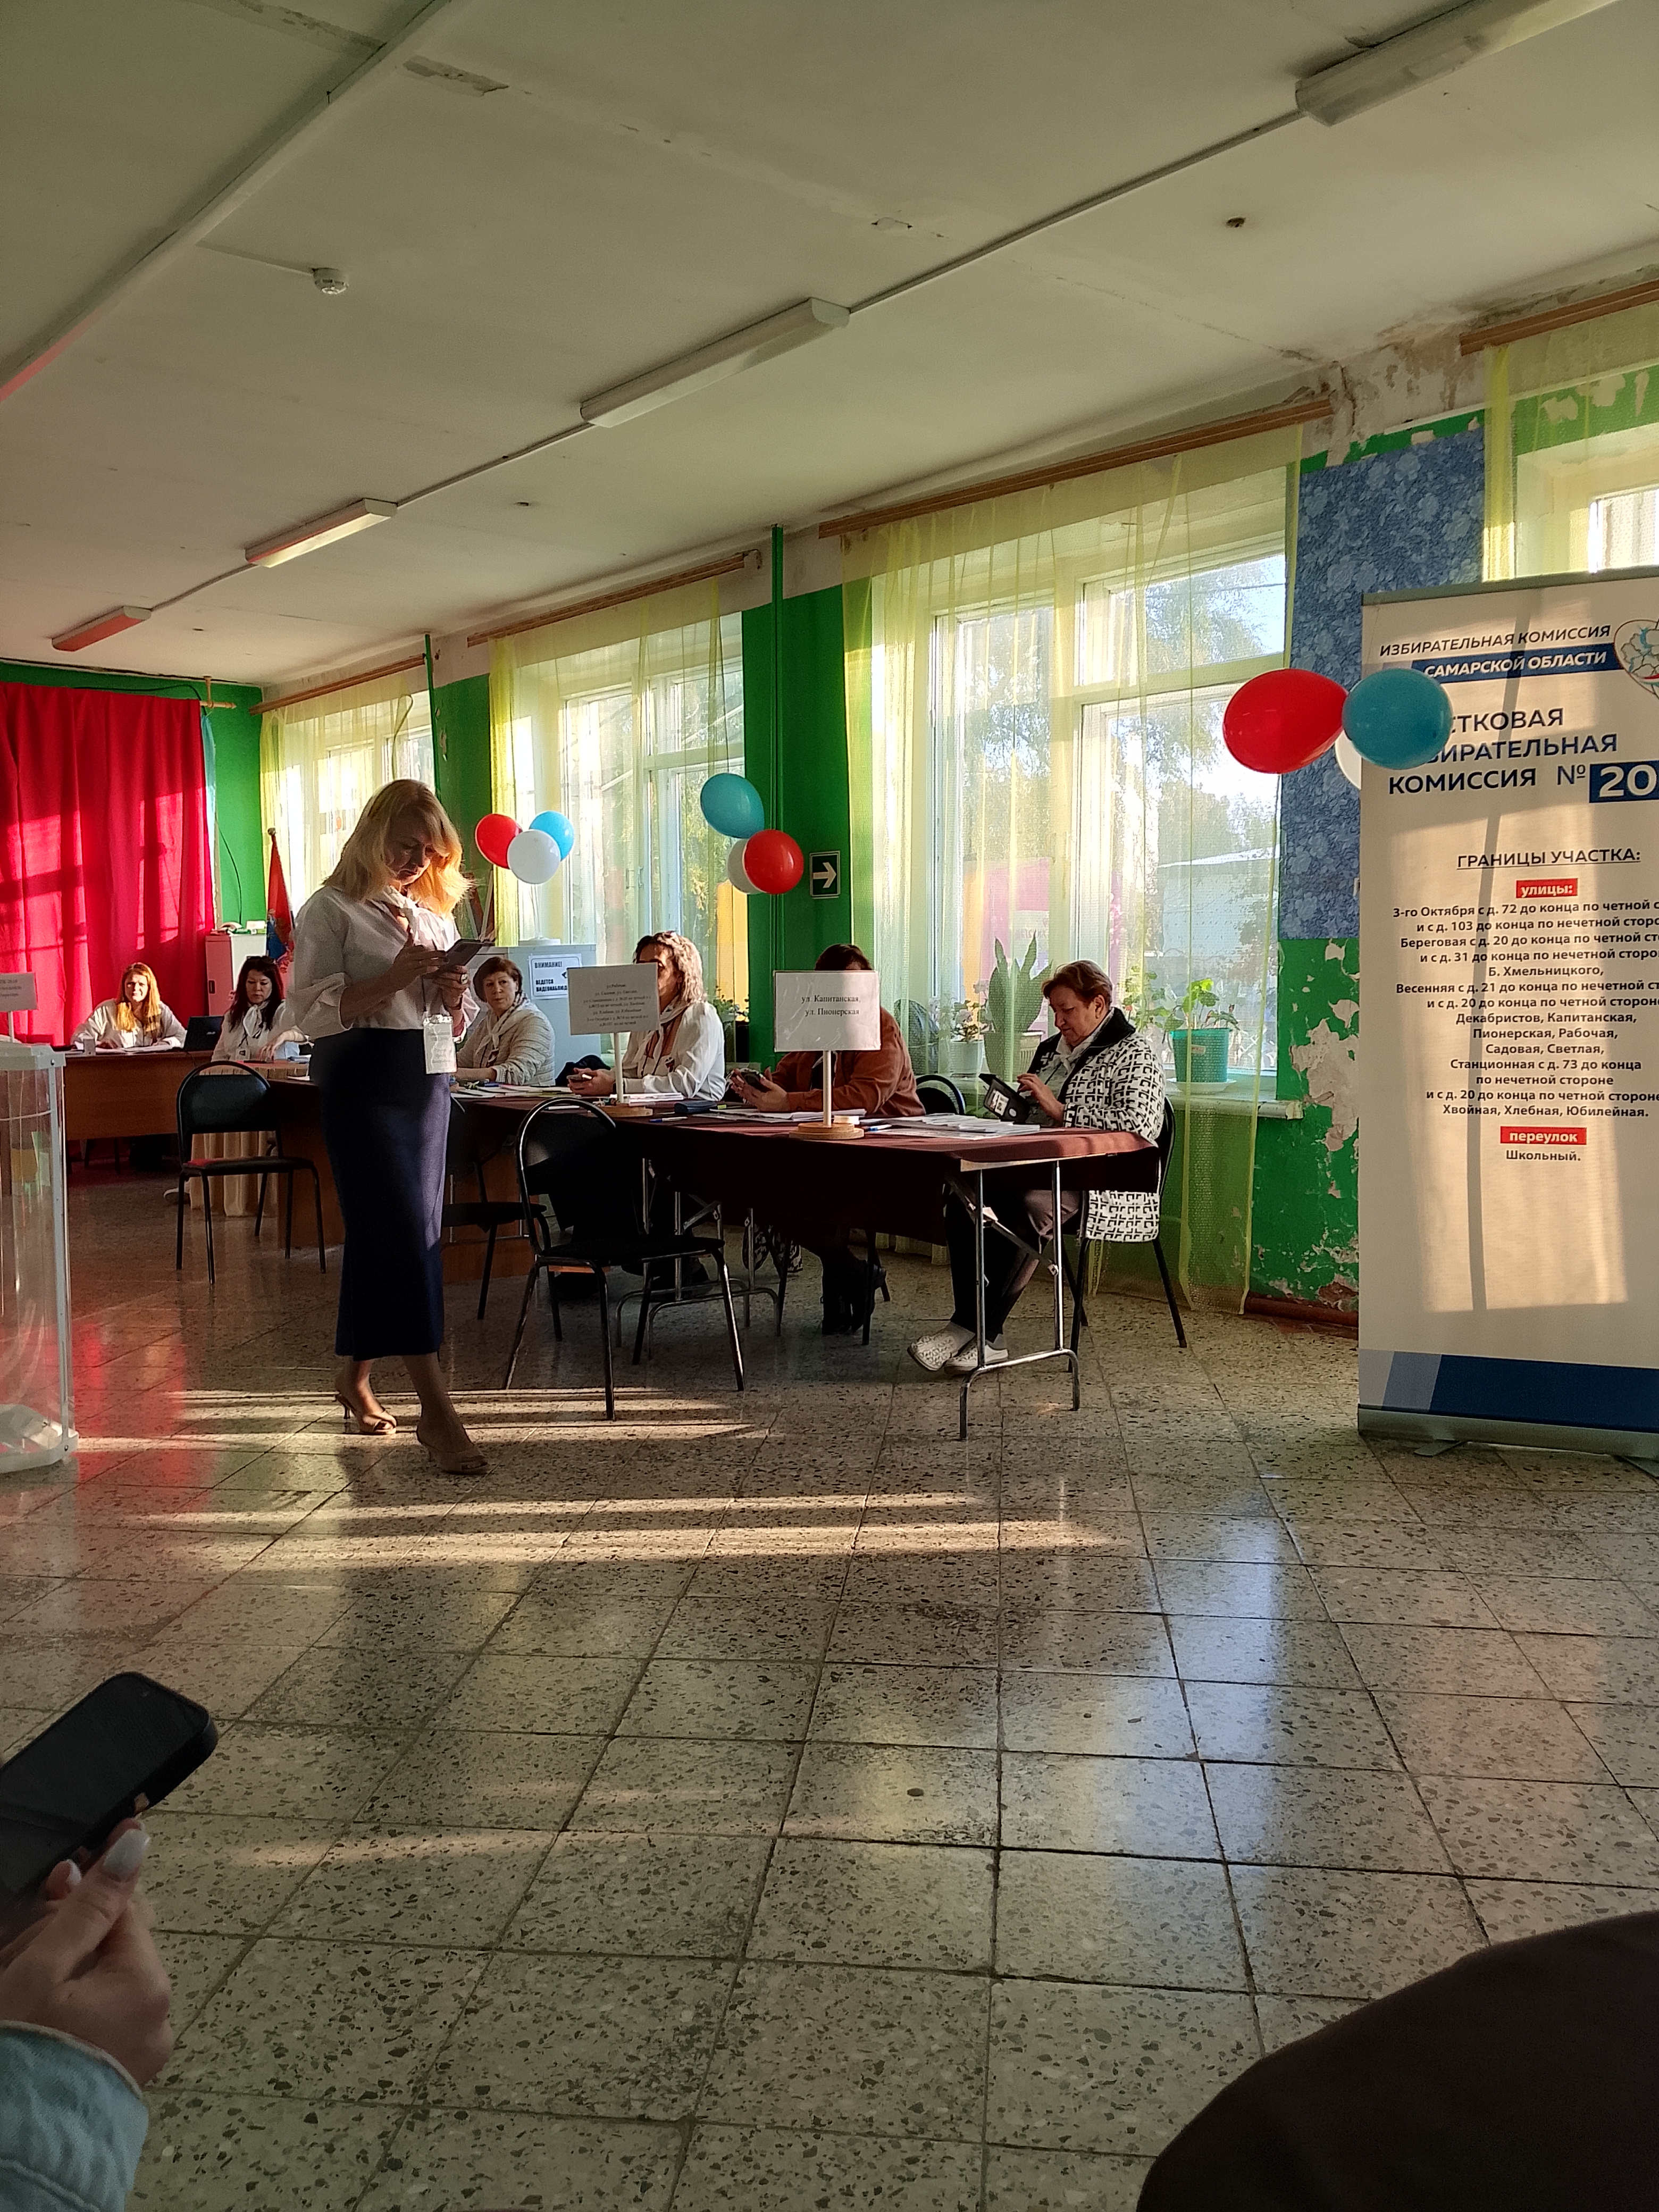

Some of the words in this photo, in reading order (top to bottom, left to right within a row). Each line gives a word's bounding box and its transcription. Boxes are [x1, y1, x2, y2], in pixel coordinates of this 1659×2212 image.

[1380, 634, 1514, 656] ИЗБИРАТЕЛЬНАЯ
[1518, 625, 1610, 644] КОМИССИЯ
[1425, 657, 1524, 677] САМАРСКОЙ
[1528, 652, 1606, 669] ОБЛАСТИ
[1451, 708, 1563, 734] ТКОВАЯ
[1427, 733, 1617, 763] ИРАТЕЛЬНАЯ
[1389, 768, 1536, 794] КОМИССИЯ
[1557, 765, 1585, 785] №
[1458, 852, 1546, 868] ГРАНИЦЫ
[1551, 848, 1640, 865] УЧАСТКА:
[1521, 884, 1573, 898] улицы:
[1393, 908, 1418, 918] 3-го
[1421, 906, 1474, 917] Октября
[1487, 906, 1498, 917] д.
[1502, 905, 1516, 914] 72
[1520, 905, 1537, 915] до
[1540, 904, 1579, 914] конца
[1583, 903, 1599, 911] по
[1603, 900, 1650, 911] четной
[1436, 923, 1448, 934] д.
[1452, 922, 1473, 931] 103
[1477, 922, 1492, 932] до
[1495, 921, 1534, 931] конца
[1557, 917, 1620, 928] нечетной
[1401, 938, 1466, 950] Береговая
[1478, 937, 1490, 948] д.
[1493, 936, 1509, 945] 20
[1511, 937, 1528, 946] до
[1531, 935, 1570, 945] конца
[1574, 935, 1590, 943] по
[1594, 932, 1640, 943] четной
[1439, 954, 1451, 964] д.
[1454, 953, 1468, 962] 31
[1472, 953, 1487, 963] до
[1491, 952, 1530, 962] конца
[1534, 951, 1549, 960] по
[1553, 949, 1615, 960] нечетной
[1619, 950, 1659, 960] сторо
[1489, 967, 1500, 977] Б.
[1503, 966, 1604, 978] Хмельницкого,
[1396, 984, 1455, 993] Весенняя
[1467, 984, 1478, 994] д.
[1481, 983, 1495, 992] 21
[1499, 983, 1515, 993] до
[1519, 983, 1558, 993] конца
[1562, 982, 1577, 991] по
[1581, 980, 1644, 991] нечетной
[1446, 1000, 1458, 1010] д.
[1461, 998, 1476, 1008] 20
[1479, 999, 1495, 1009] до
[1498, 999, 1537, 1009] конца
[1560, 996, 1606, 1006] четной
[1610, 998, 1659, 1009] сторон
[817, 1008, 859, 1017] Пионерская
[1456, 1014, 1544, 1025] Декабристов,
[1547, 1013, 1637, 1024] Капитанская,
[1473, 1028, 1555, 1040] Пионерская,
[1559, 1028, 1618, 1040] Рабочая,
[1486, 1045, 1544, 1056] Садовая,
[1547, 1044, 1604, 1055] Светлая,
[1451, 1060, 1535, 1071] Станционная
[1547, 1061, 1559, 1071] д.
[1562, 1060, 1578, 1069] 73
[1581, 1061, 1597, 1071] до
[1601, 1061, 1641, 1071] конца
[1495, 1074, 1556, 1085] нечетной
[1560, 1077, 1613, 1086] стороне
[1446, 1091, 1457, 1102] д.
[1460, 1090, 1475, 1100] 20
[1477, 1092, 1494, 1102] до
[1497, 1092, 1536, 1102] конца
[1539, 1092, 1555, 1100] по
[1559, 1090, 1605, 1100] четной
[1443, 1105, 1501, 1116] Хвойная,
[1504, 1106, 1563, 1117] Хлебная,
[1566, 1107, 1648, 1117] Юбилейная.
[1510, 1132, 1578, 1143] переулок
[1506, 1150, 1581, 1161] Школьный.
